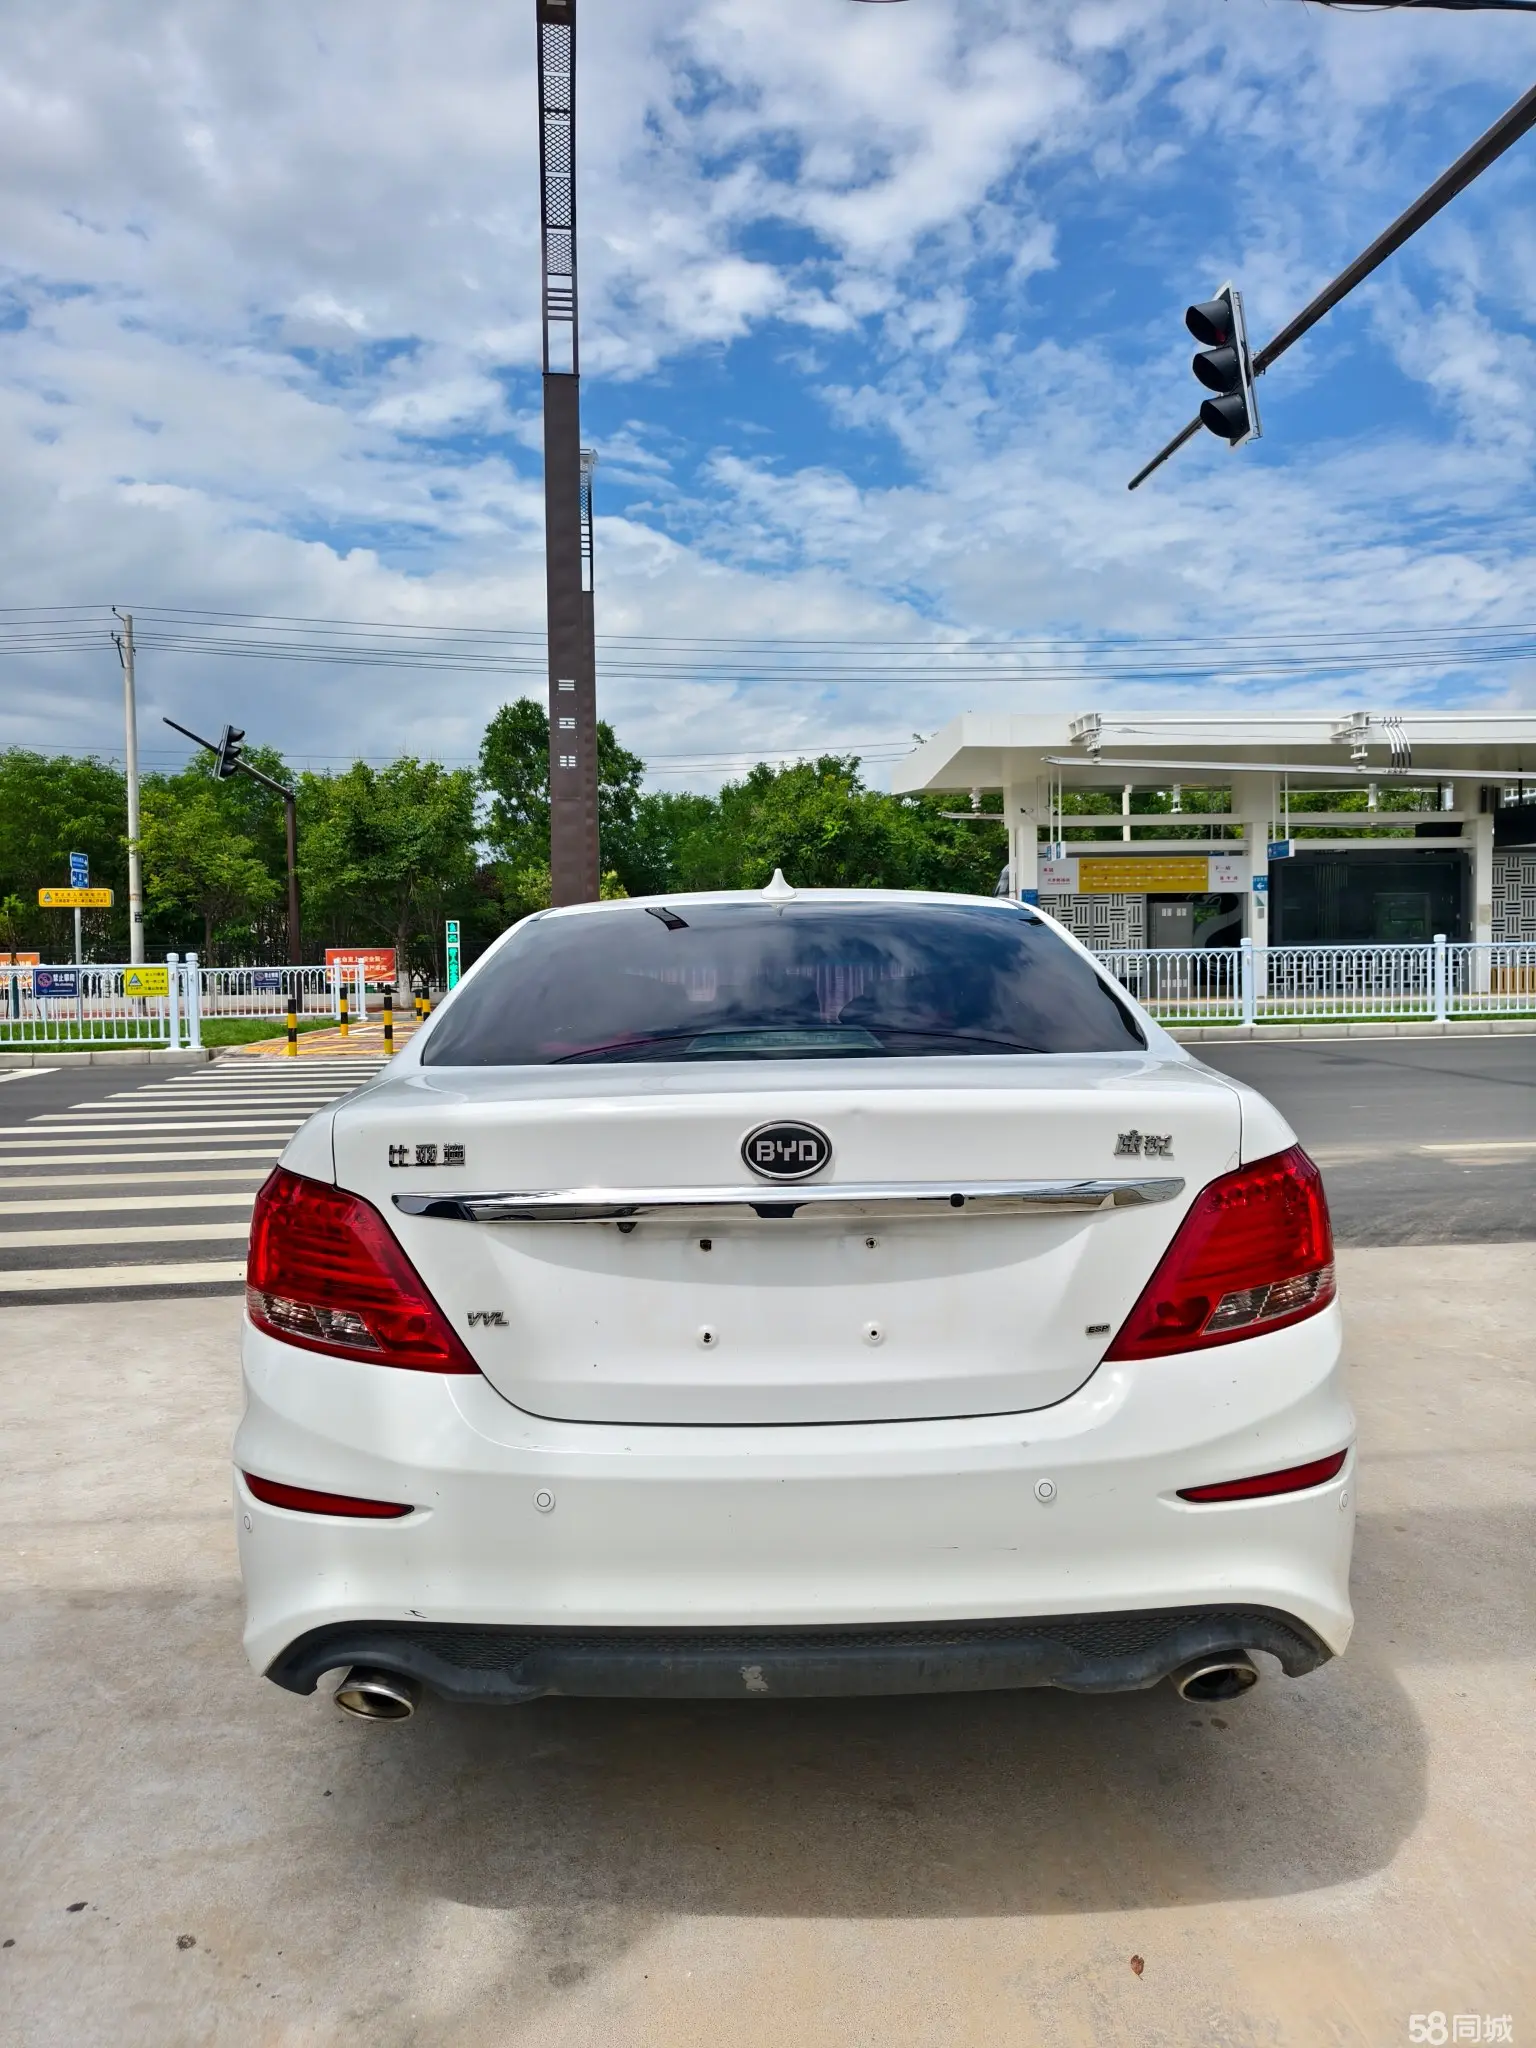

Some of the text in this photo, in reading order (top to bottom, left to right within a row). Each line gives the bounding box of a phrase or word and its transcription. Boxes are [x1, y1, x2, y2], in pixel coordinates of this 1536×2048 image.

[756, 1140, 818, 1162] BYD
[1113, 1129, 1174, 1157] 速锐
[388, 1143, 465, 1167] 比亚迪
[467, 1311, 510, 1328] VVL
[1086, 1324, 1110, 1334] ESP
